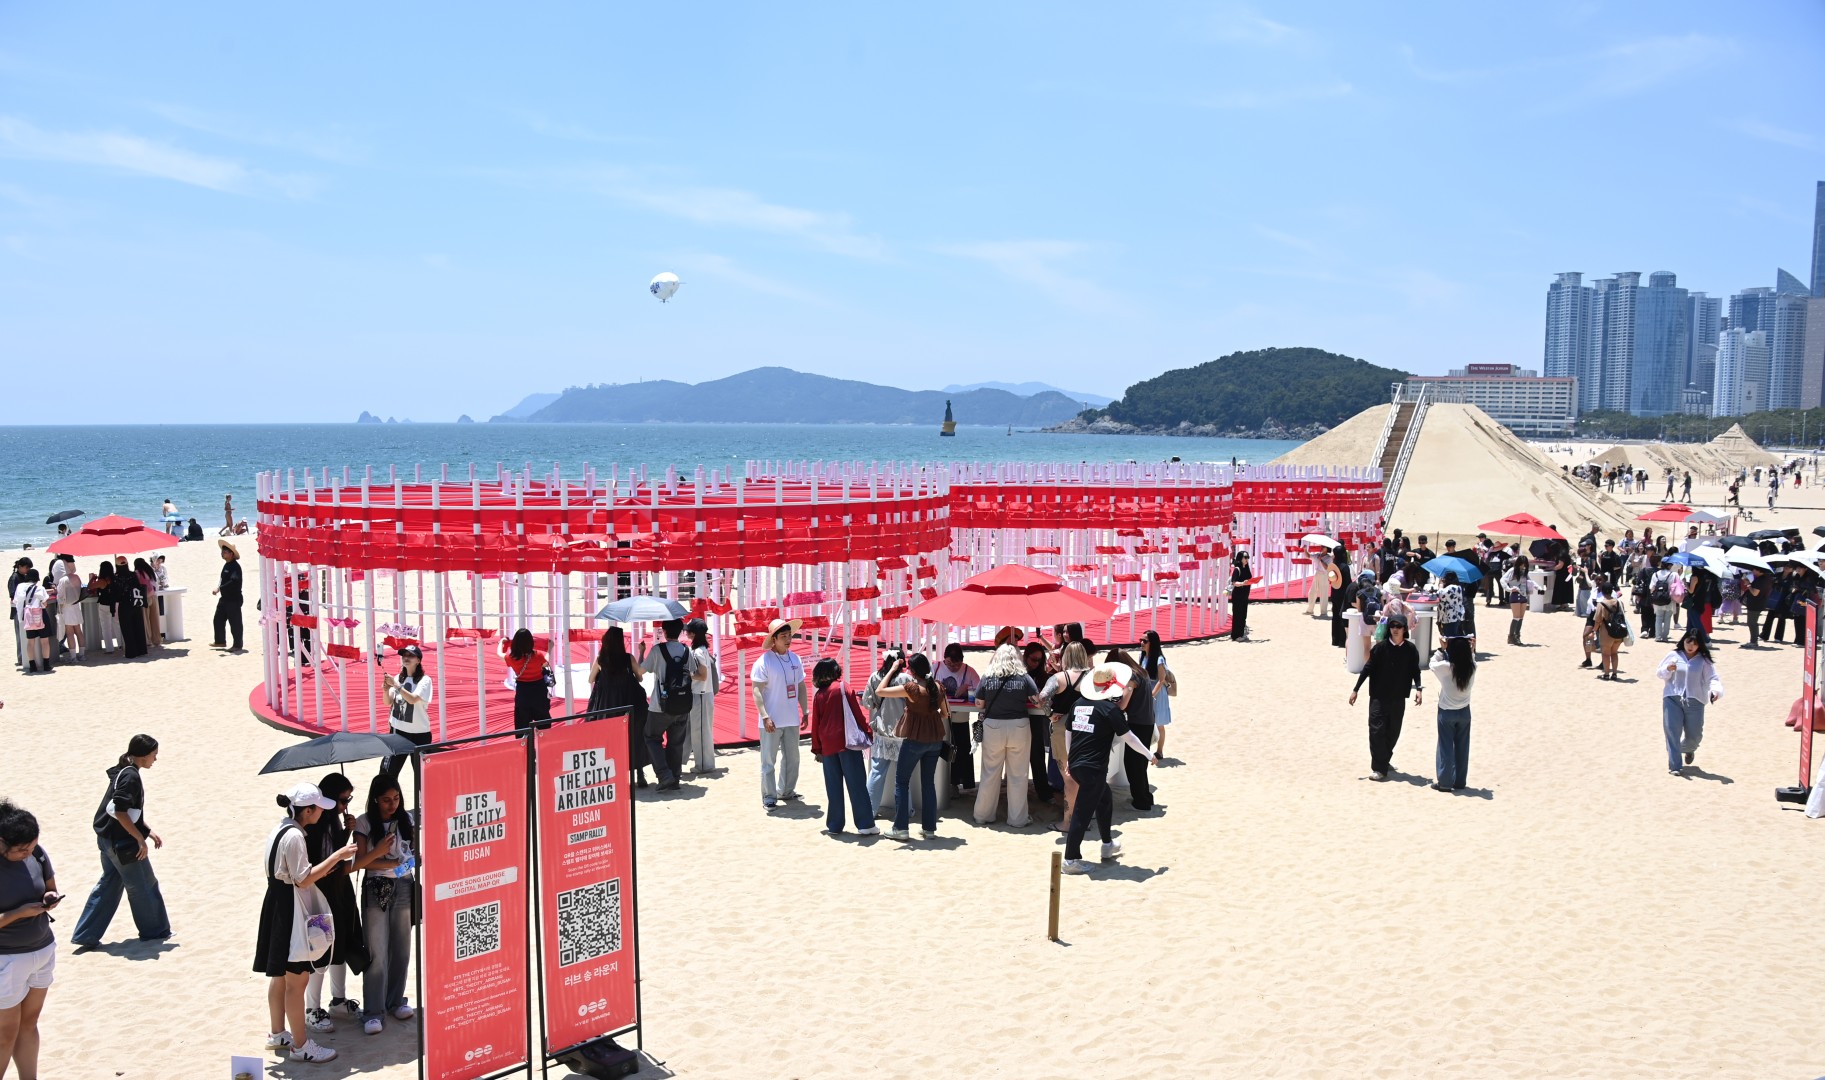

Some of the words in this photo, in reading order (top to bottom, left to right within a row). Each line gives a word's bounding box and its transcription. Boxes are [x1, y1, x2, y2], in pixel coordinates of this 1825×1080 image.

[573, 751, 596, 770] BTS
[559, 772, 580, 791] THE
[585, 766, 610, 786] CITY
[465, 794, 487, 812] BTS
[558, 784, 613, 811] ARIRANG
[453, 813, 473, 830] THE
[477, 807, 501, 825] CITY
[573, 809, 600, 826] BUSAN
[450, 824, 503, 848] ARIRANG
[570, 831, 588, 843] STAMP
[589, 828, 603, 838] RALLY
[464, 846, 490, 862] BUSAN
[465, 877, 481, 886] SONG
[483, 871, 505, 881] LOUNGE
[455, 886, 476, 894] DIGITAL
[565, 973, 582, 986] 러브
[584, 970, 592, 981] 송
[594, 961, 617, 977] 라운지
